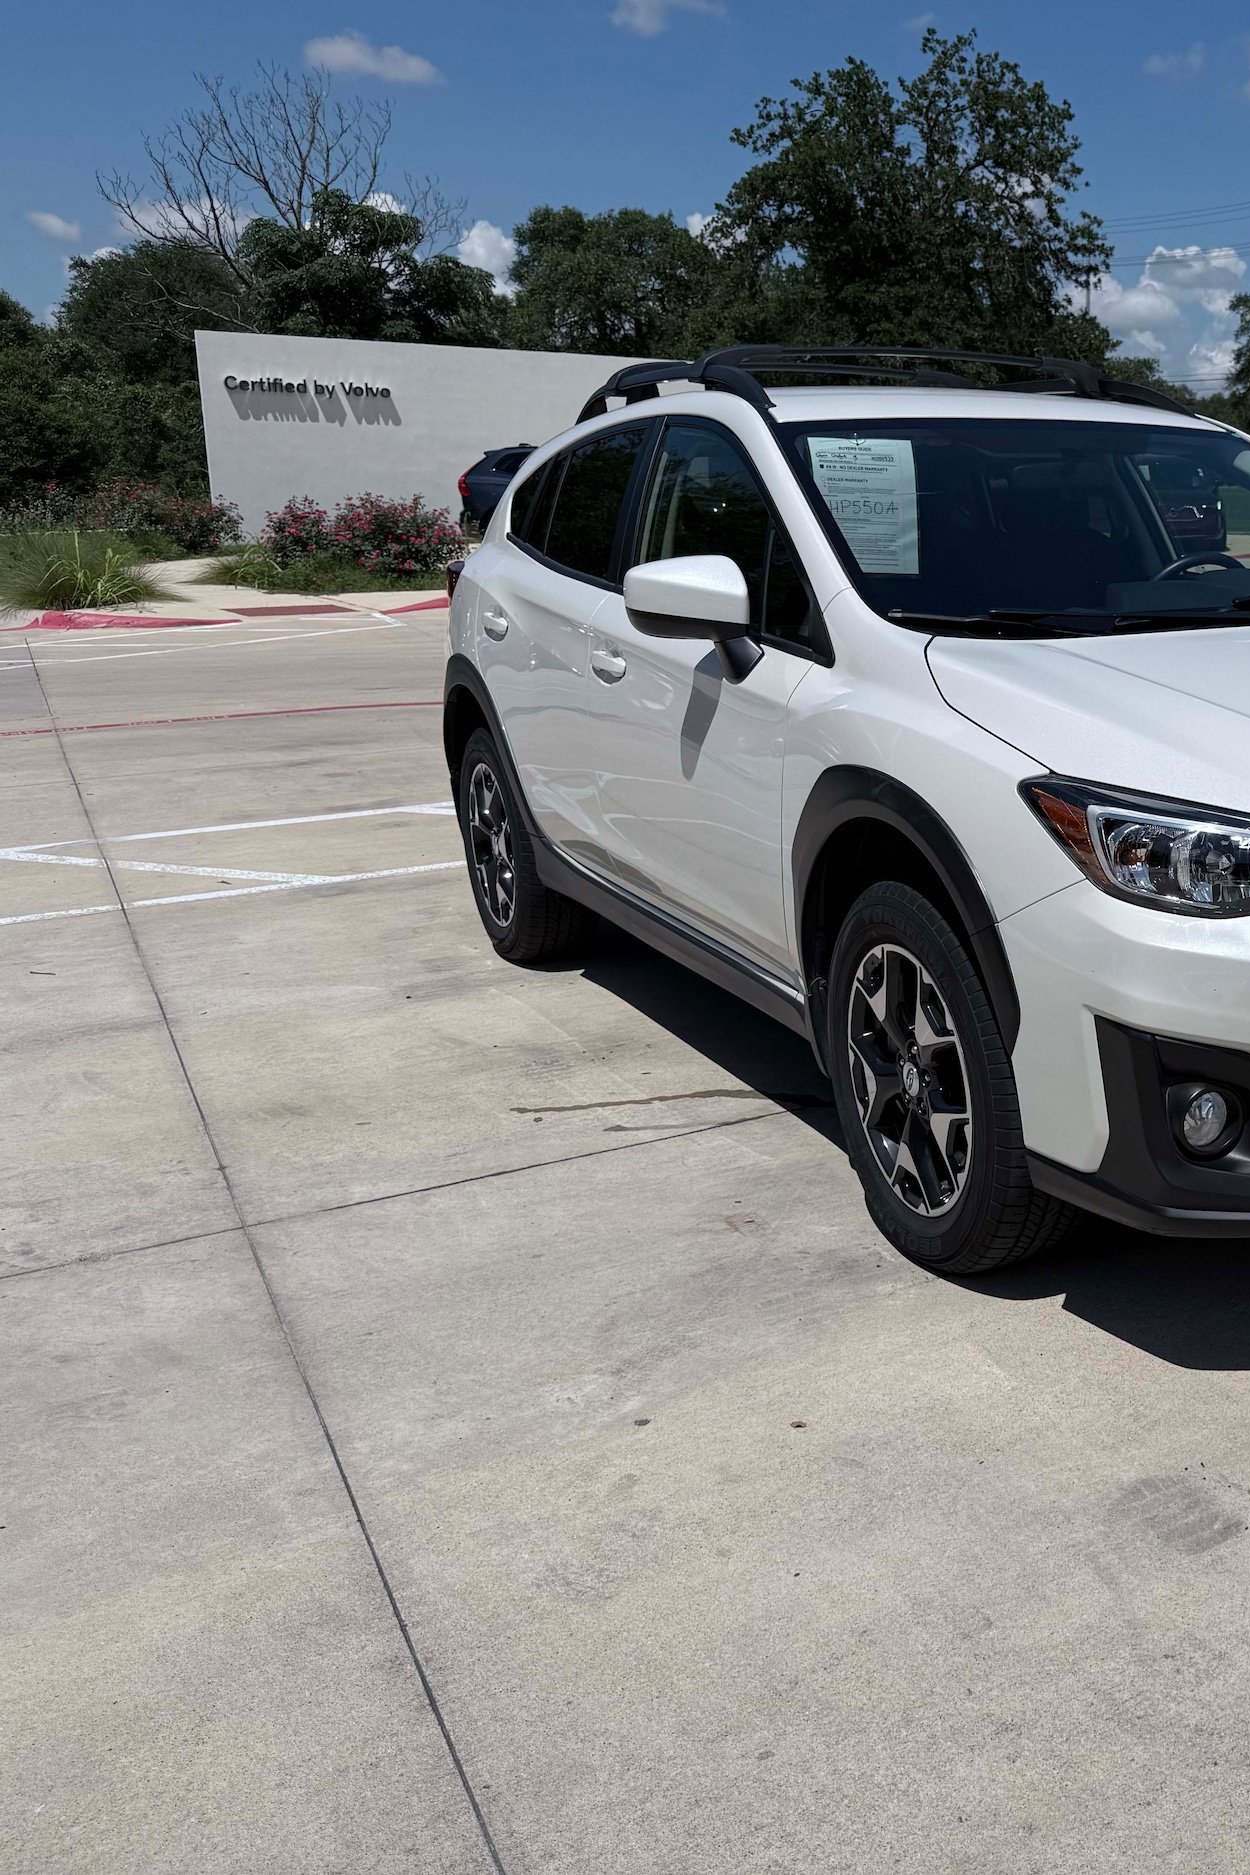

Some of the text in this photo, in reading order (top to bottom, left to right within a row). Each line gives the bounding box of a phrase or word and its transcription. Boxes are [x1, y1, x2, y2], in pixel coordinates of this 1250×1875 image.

[223, 375, 391, 399] Certified by Volvo
